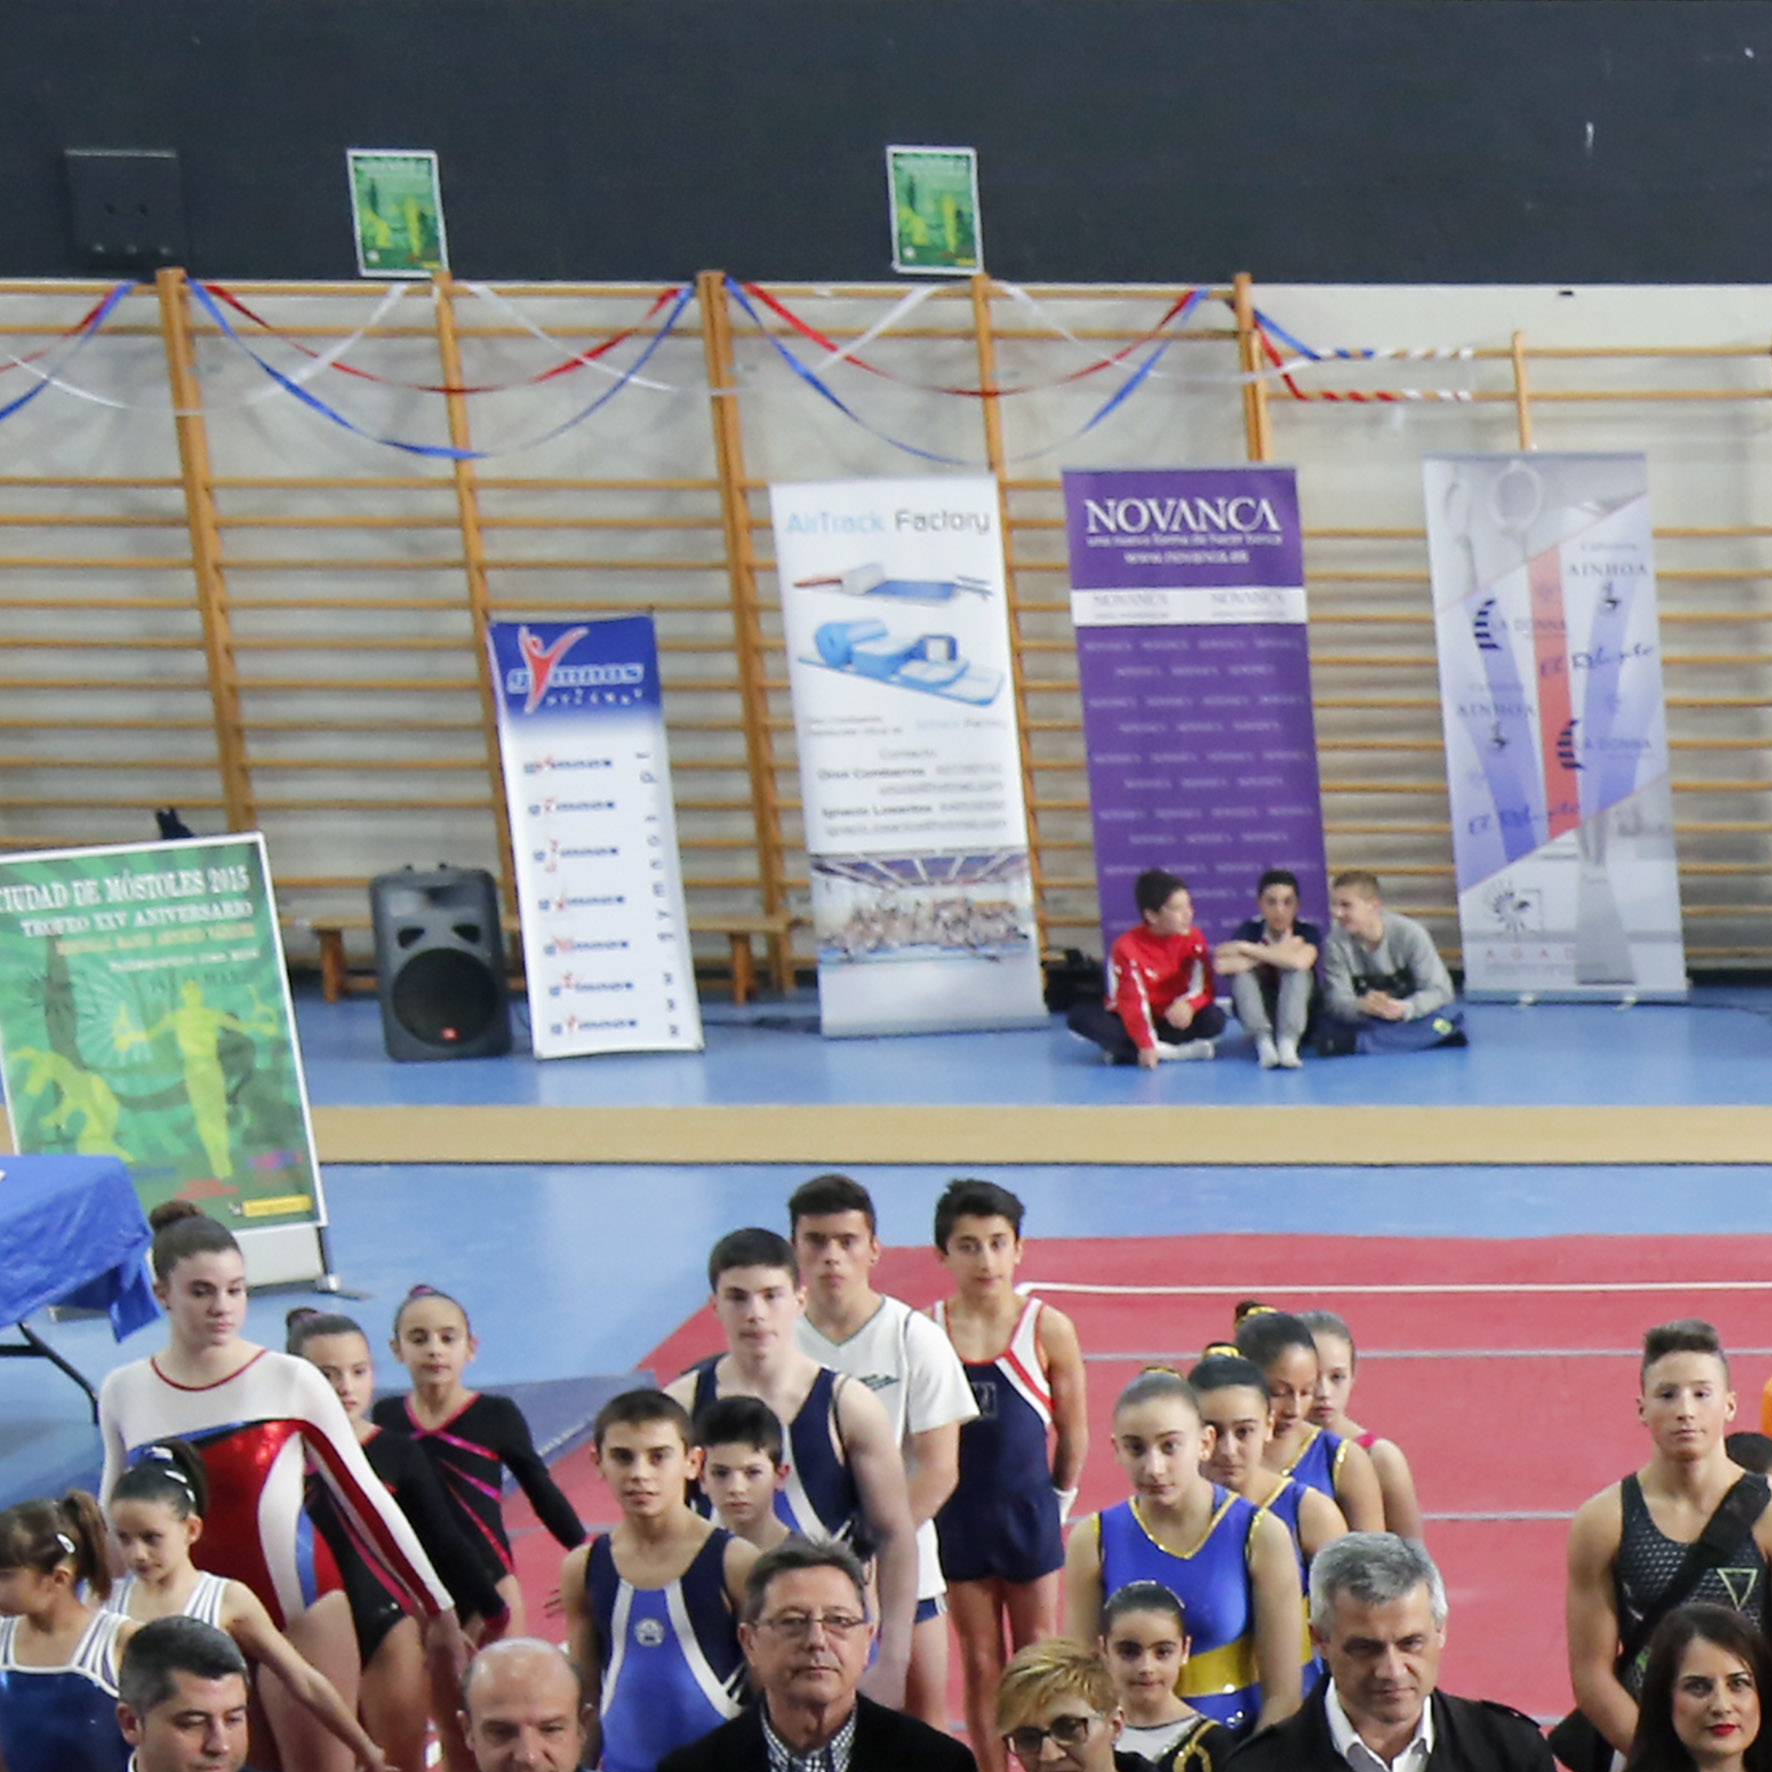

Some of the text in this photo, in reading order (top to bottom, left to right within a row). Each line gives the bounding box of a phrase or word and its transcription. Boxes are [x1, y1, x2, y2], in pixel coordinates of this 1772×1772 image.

[786, 508, 991, 536] AirTrack Factory
[1085, 496, 1282, 534] NOVANCA
[71, 879, 101, 907] DE
[104, 868, 206, 903] MÓSTOLES
[134, 899, 253, 927] ANIVERSARIO
